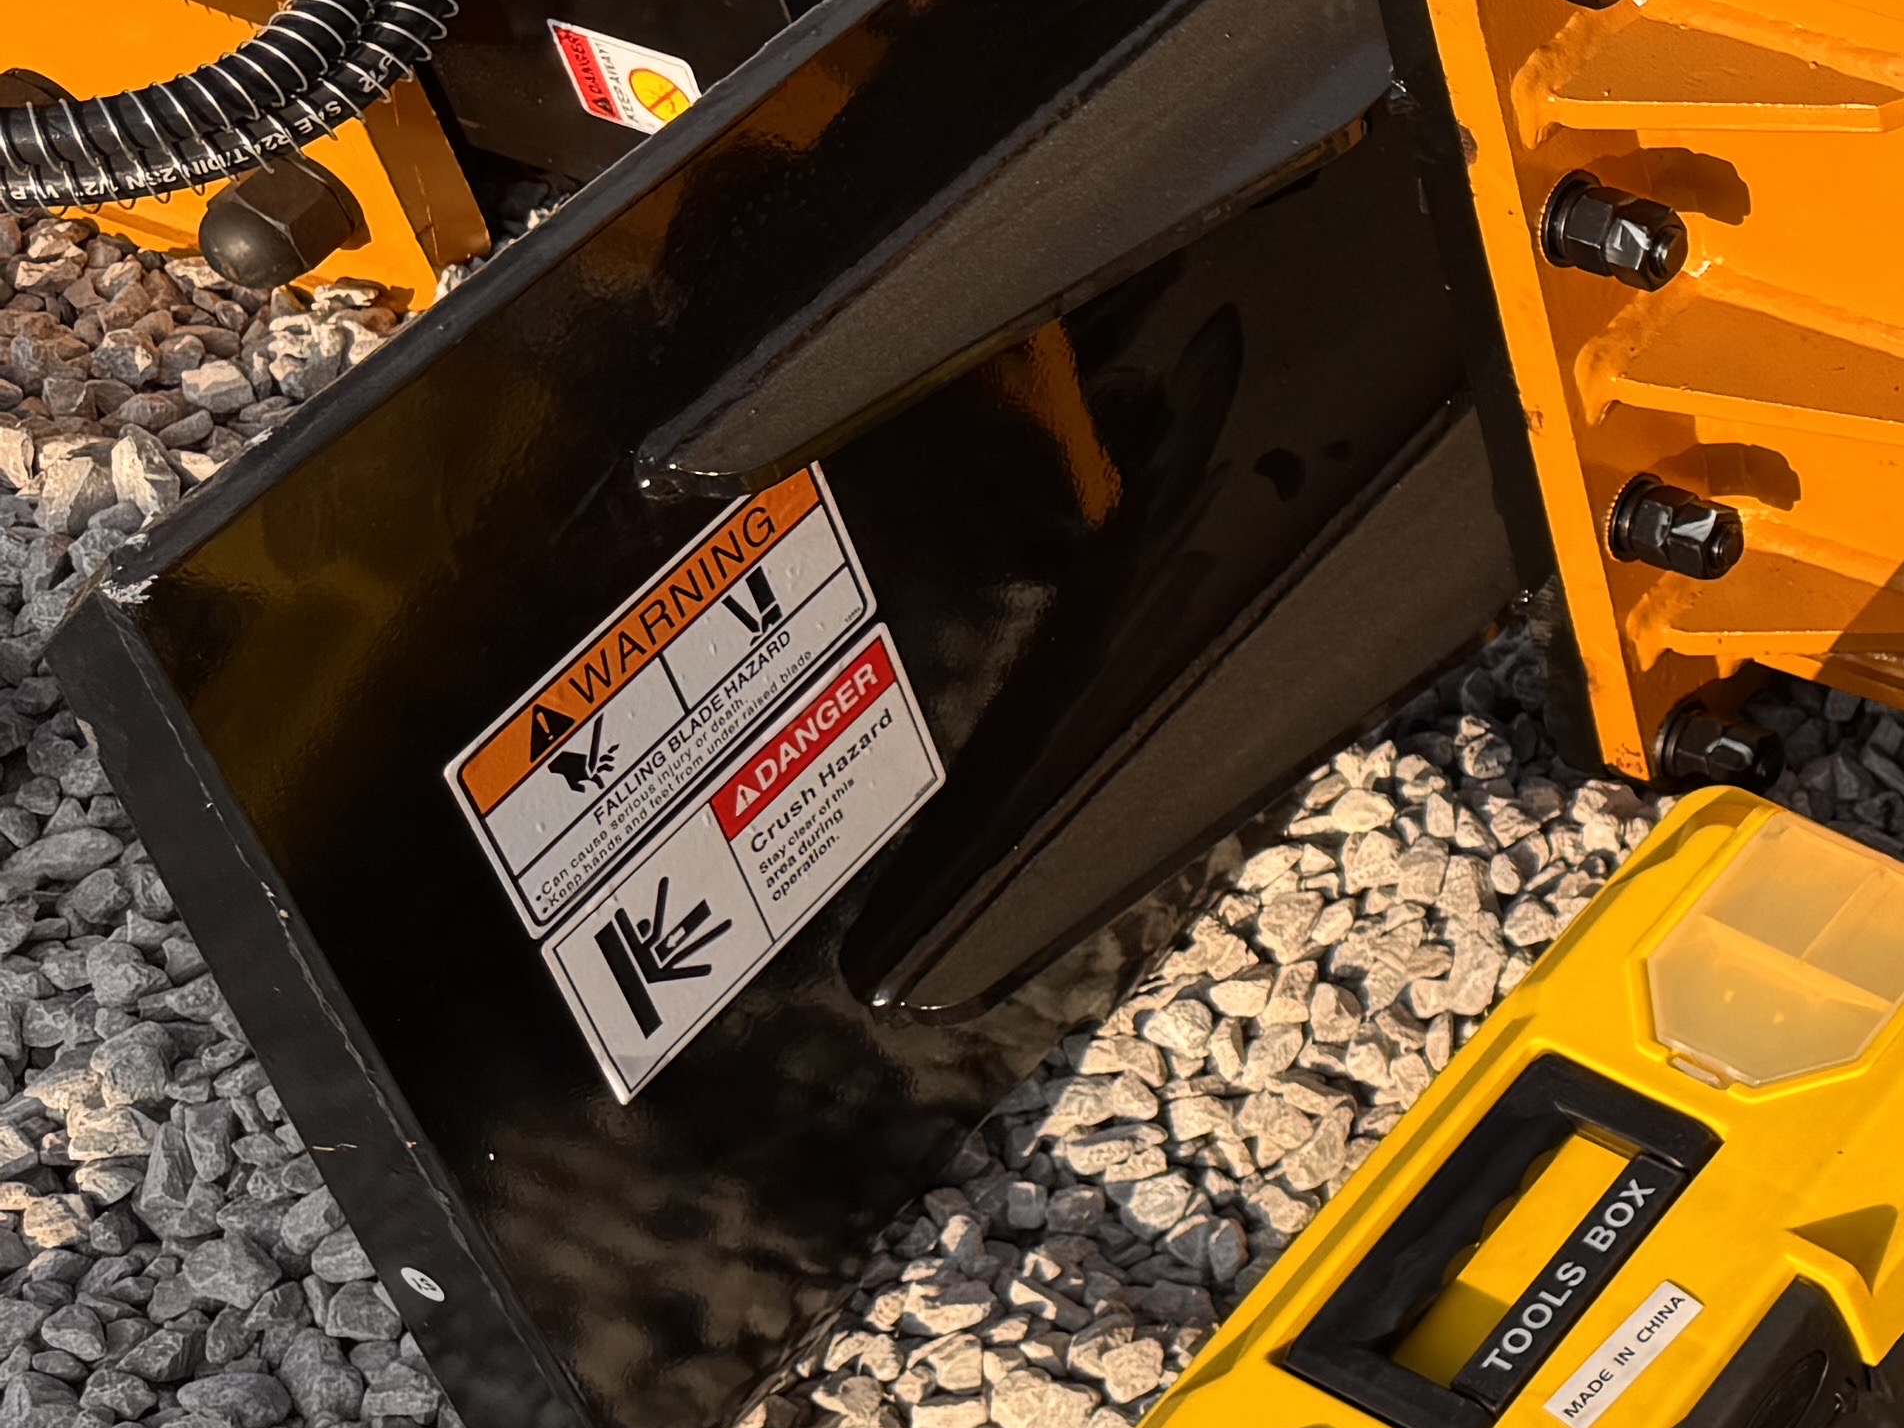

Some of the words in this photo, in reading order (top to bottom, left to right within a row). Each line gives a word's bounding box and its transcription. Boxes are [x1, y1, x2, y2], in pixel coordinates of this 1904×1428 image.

[298, 100, 344, 136] SAE
[568, 506, 777, 706] WARNING
[550, 873, 583, 909] Keep
[582, 834, 624, 875] hands
[625, 808, 649, 836] and
[649, 780, 675, 810] feet
[674, 755, 705, 791] from
[707, 720, 741, 757] under
[742, 680, 780, 722] raised
[592, 750, 667, 826] FALLING
[667, 694, 725, 753] BLADE
[723, 629, 792, 700] HAZARD
[750, 783, 817, 854] Crush
[816, 707, 894, 788] Hazard
[753, 662, 879, 792] DANGER
[541, 868, 570, 896] Can
[570, 827, 609, 869] cause
[611, 783, 658, 831] serious
[658, 747, 693, 786] injury
[695, 734, 709, 750] or
[758, 844, 788, 875] Stay
[787, 809, 819, 847] clear
[818, 797, 833, 817] of
[831, 777, 856, 803] this
[765, 856, 799, 889] area
[797, 807, 845, 857] during
[771, 834, 841, 903] operation.
[1479, 1260, 1588, 1372] TOOLS
[1581, 1177, 1658, 1253] BOX
[1562, 1367, 1615, 1419] MADE
[1613, 1345, 1636, 1368] IN
[1636, 1294, 1687, 1344] CHINA
